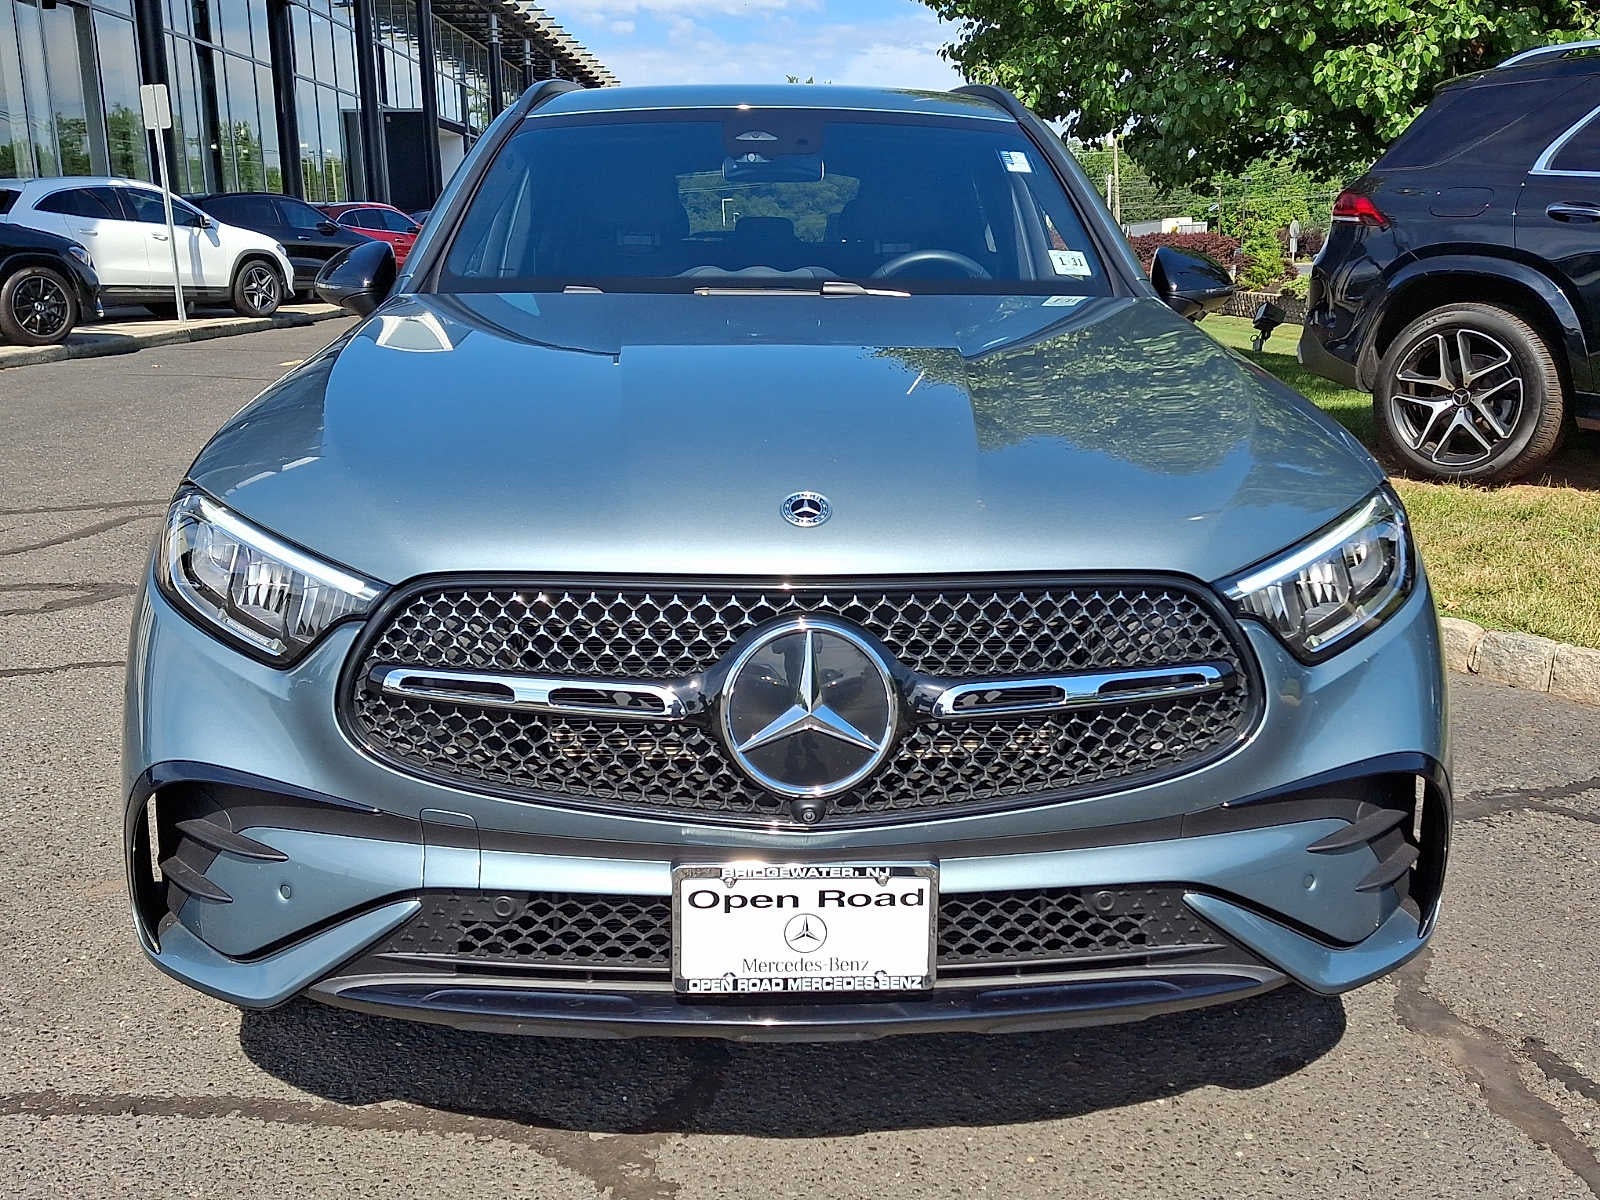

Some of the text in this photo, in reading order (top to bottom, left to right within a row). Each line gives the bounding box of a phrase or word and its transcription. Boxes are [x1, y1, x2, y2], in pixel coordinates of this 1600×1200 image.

[865, 867, 891, 878] NJ
[687, 888, 924, 913] Open Road
[742, 957, 869, 973] Mercedes-Benz
[688, 978, 733, 992] OPEN
[737, 978, 783, 992] ROAD
